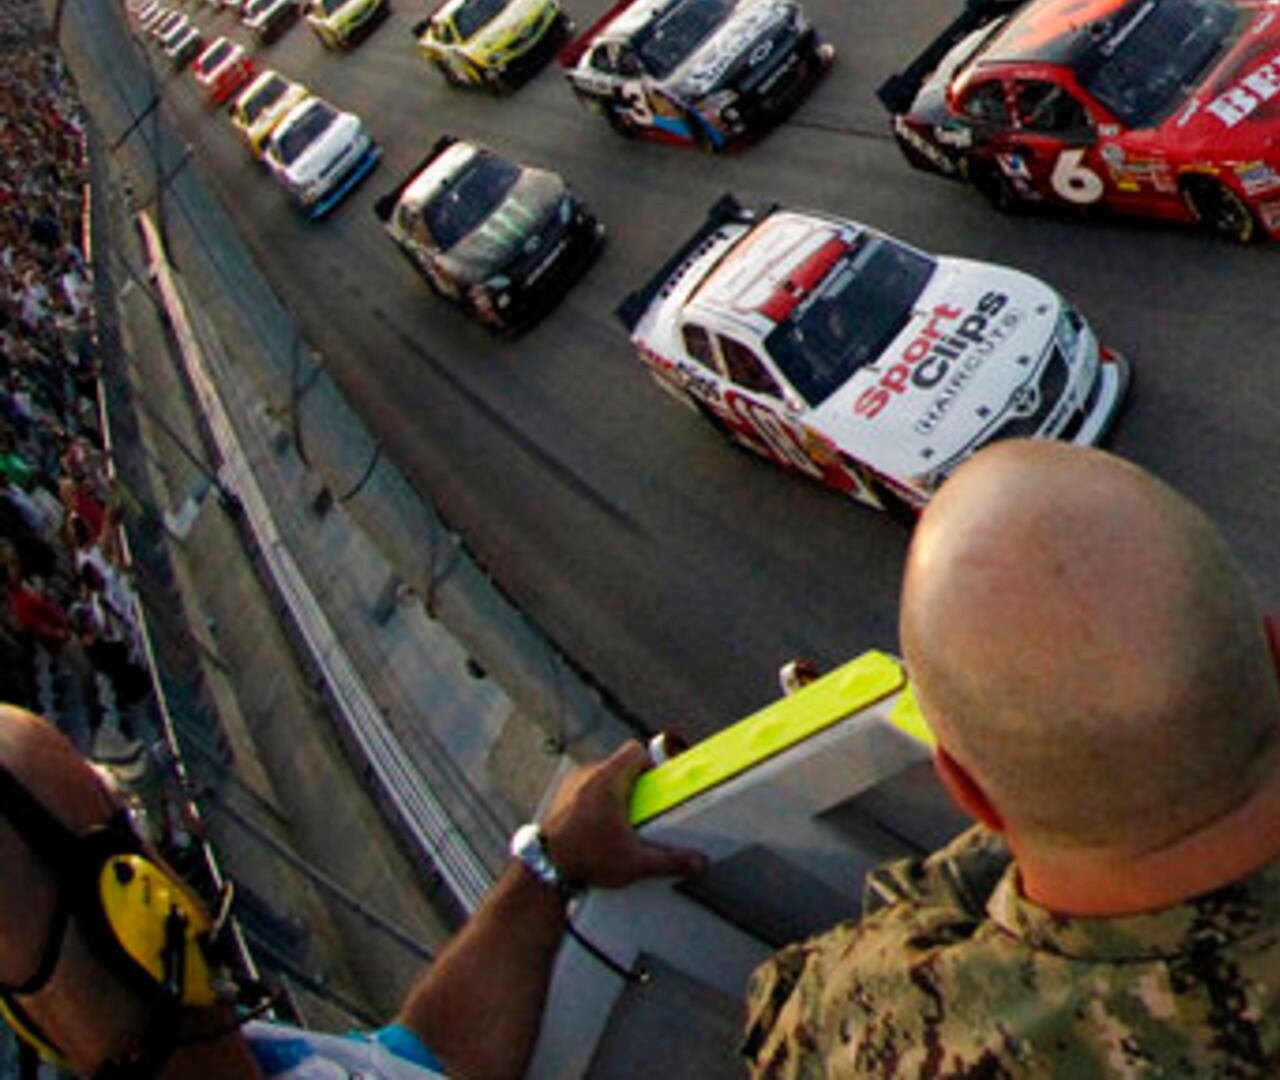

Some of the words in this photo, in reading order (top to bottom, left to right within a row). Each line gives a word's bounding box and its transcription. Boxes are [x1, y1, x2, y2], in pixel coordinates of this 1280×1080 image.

[1050, 148, 1104, 204] 6
[853, 300, 964, 420] Sport
[910, 291, 1009, 390] Clips
